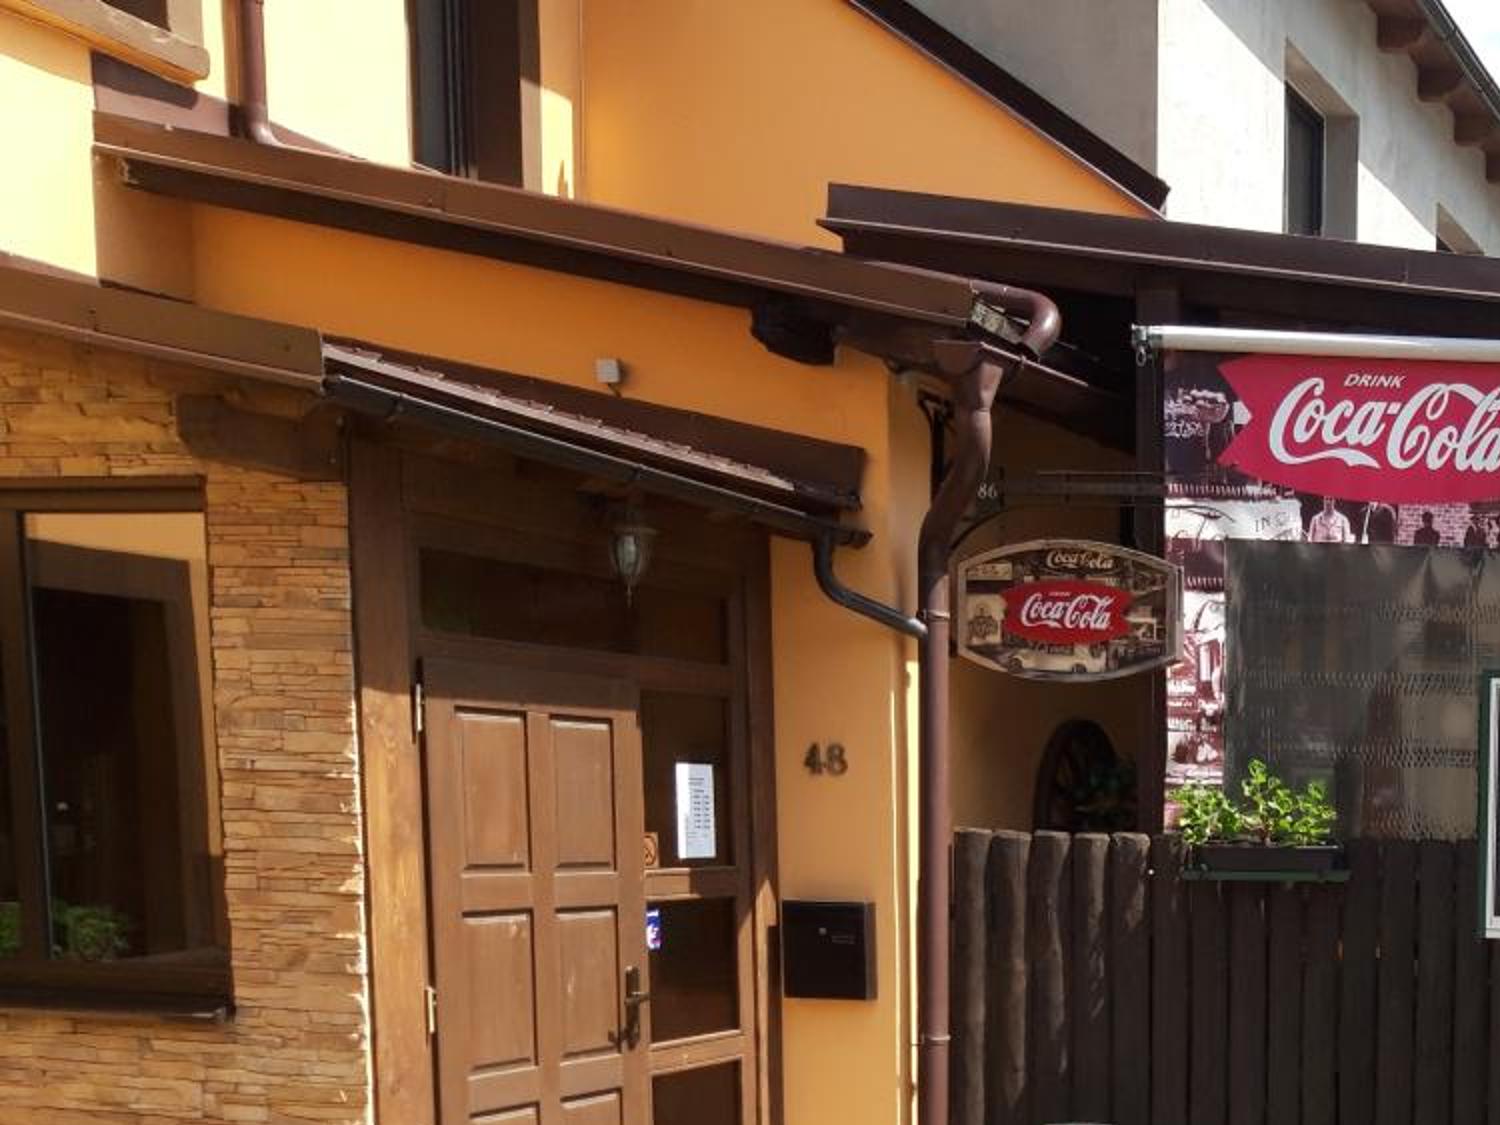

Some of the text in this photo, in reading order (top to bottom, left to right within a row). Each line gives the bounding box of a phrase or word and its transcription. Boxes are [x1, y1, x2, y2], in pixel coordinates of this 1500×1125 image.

[1344, 373, 1407, 389] DRINK
[1020, 592, 1116, 630] Coca-Cola
[803, 742, 849, 777] 48
